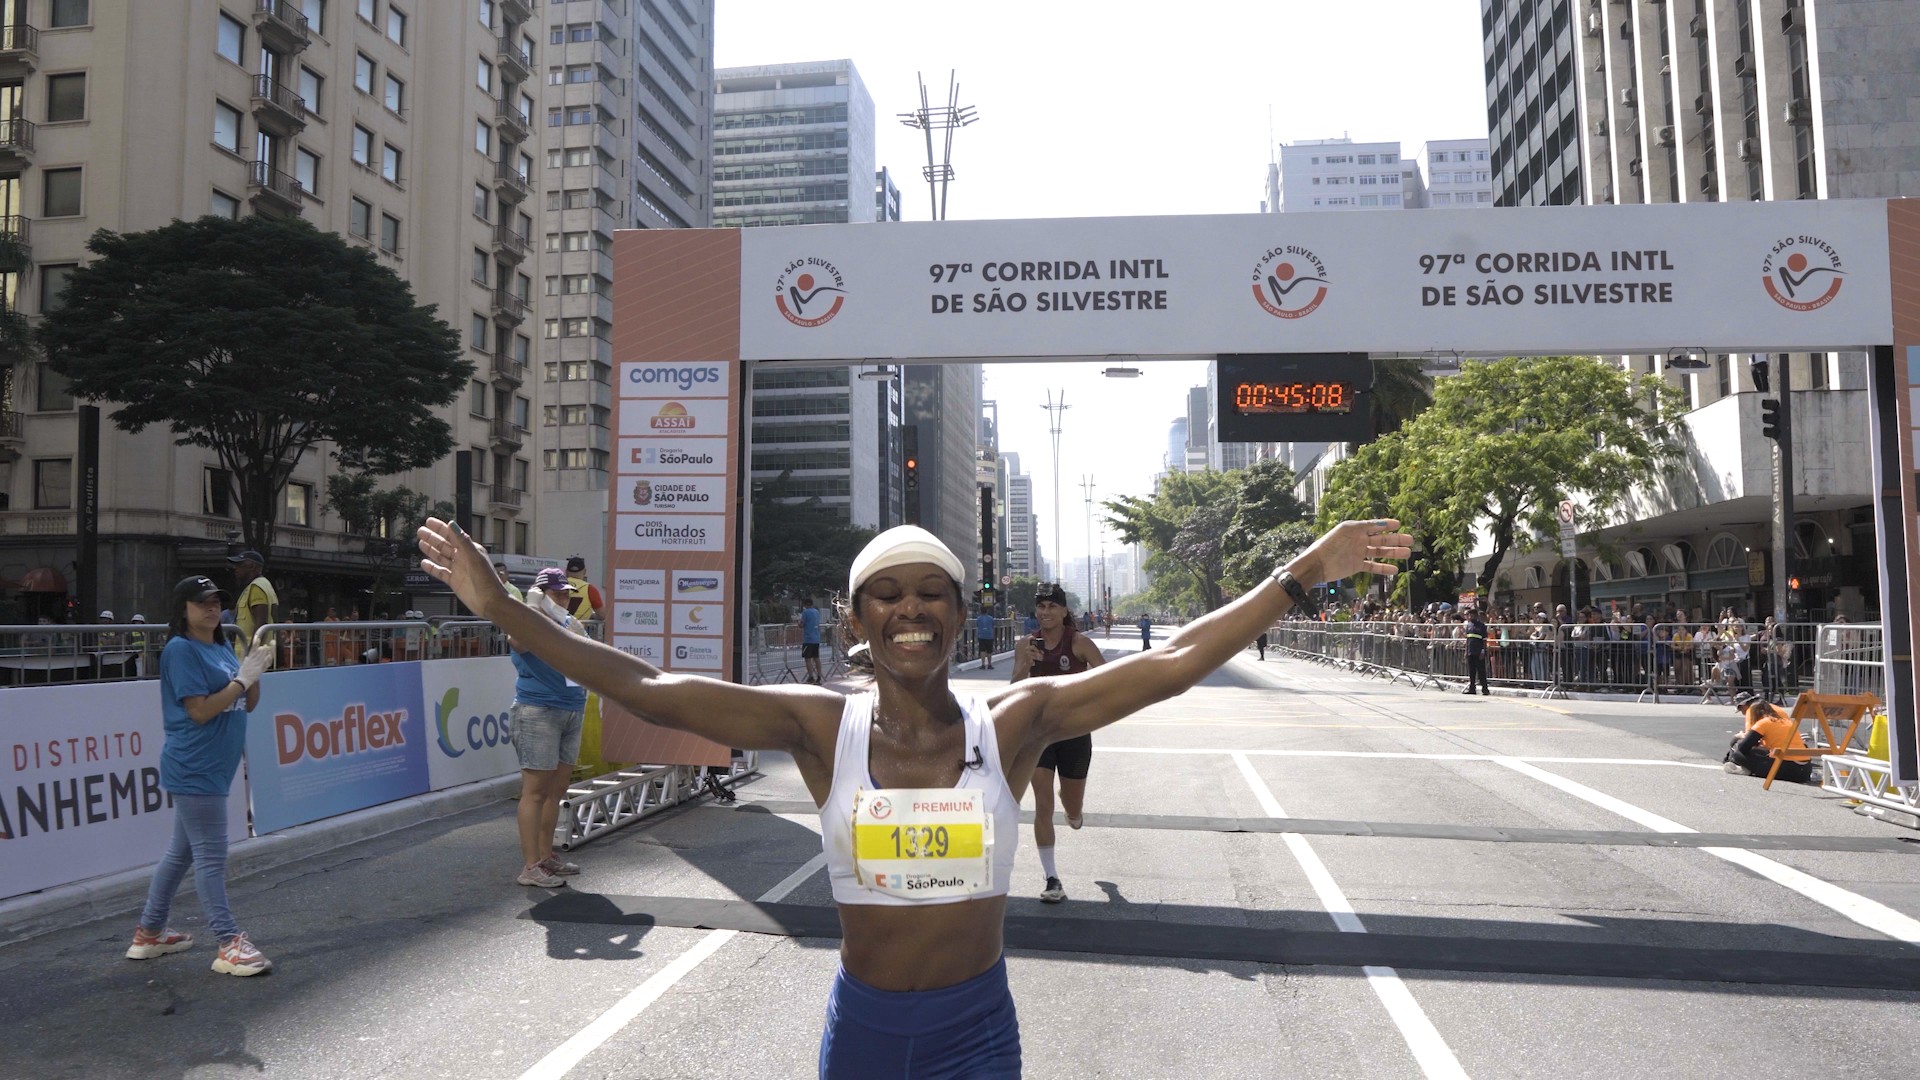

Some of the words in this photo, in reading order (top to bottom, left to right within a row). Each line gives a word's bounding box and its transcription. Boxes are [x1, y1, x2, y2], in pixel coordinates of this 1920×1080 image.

[1262, 247, 1283, 264] SÃO
[1286, 246, 1327, 277] SILVESTRE
[1475, 251, 1601, 274] CORRIDA
[1611, 250, 1674, 271] INTL
[1772, 237, 1794, 254] SÃO
[1799, 236, 1841, 268] SILVESTRE
[785, 259, 804, 274] SÃO
[808, 257, 844, 287] SILVESTRE
[982, 260, 1100, 282] CORRIDA
[1110, 259, 1169, 279] INTL
[931, 294, 963, 314] DE
[973, 287, 1027, 313] SÃO
[1036, 290, 1167, 312] SILVESTRE
[1422, 286, 1456, 306] DE
[1466, 279, 1524, 306] SÃO
[1534, 282, 1672, 305] SILVESTRE
[1785, 302, 1807, 310] PAULO
[1812, 296, 1832, 309] BRASIL
[817, 313, 834, 325] BRASIL
[1274, 309, 1293, 317] PAULO
[1298, 304, 1317, 316] BRASIL
[1236, 384, 1342, 407] 00:45:08
[660, 454, 713, 464] SãoPaulo
[86, 467, 94, 514] Paulista
[654, 492, 674, 502] SÃO
[677, 494, 709, 502] PAULO
[635, 524, 706, 537] Cunhados
[13, 731, 142, 771] DISTRITO
[913, 801, 973, 812] PREMIUM
[891, 826, 949, 858] 1329
[907, 876, 964, 890] SãoPaulo
